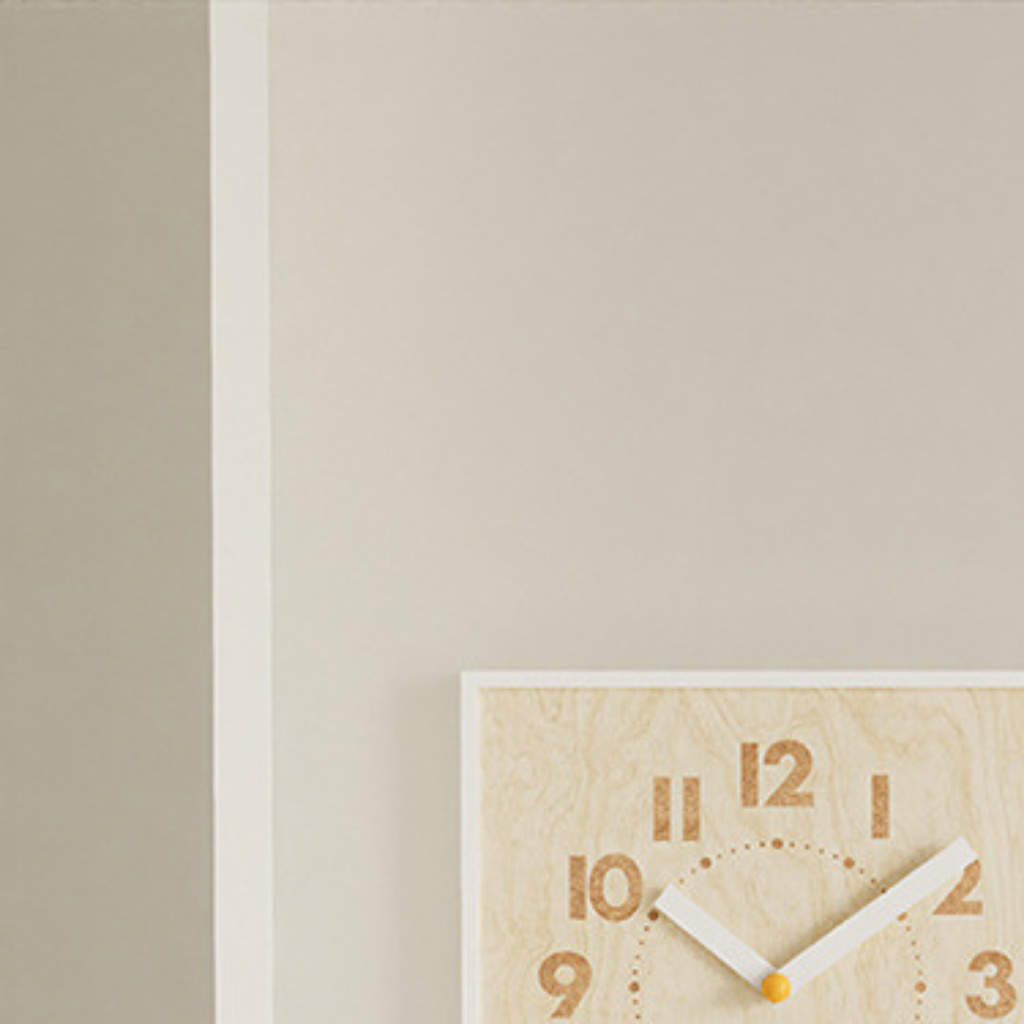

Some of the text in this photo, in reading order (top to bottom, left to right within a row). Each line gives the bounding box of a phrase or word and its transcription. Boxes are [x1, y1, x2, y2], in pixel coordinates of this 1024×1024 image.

[740, 739, 814, 807] 12
[871, 775, 890, 838] 1
[653, 777, 700, 841] 11
[568, 853, 643, 922] 10
[931, 859, 984, 915] 2
[537, 950, 593, 1019] 9
[964, 950, 1018, 1019] 3
